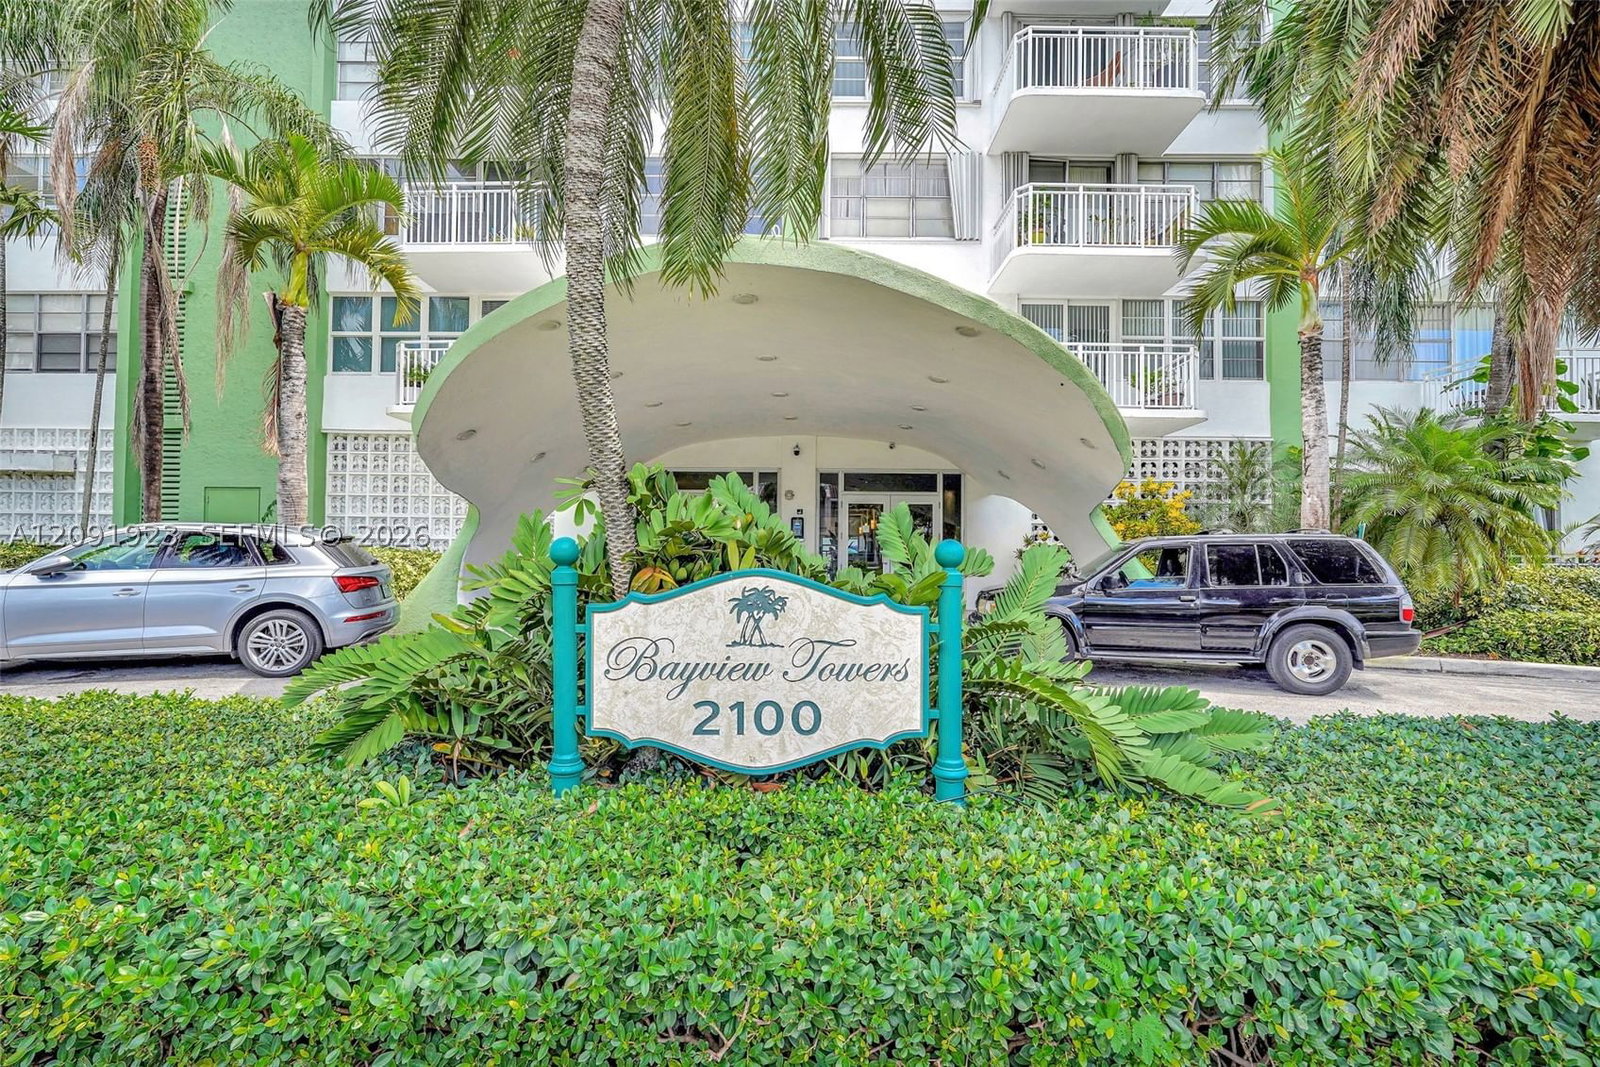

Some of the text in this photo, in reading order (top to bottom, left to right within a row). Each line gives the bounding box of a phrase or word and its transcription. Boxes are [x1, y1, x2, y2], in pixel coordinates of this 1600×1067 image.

[604, 636, 909, 701] Bayview Towers
[692, 700, 822, 736] 2100
